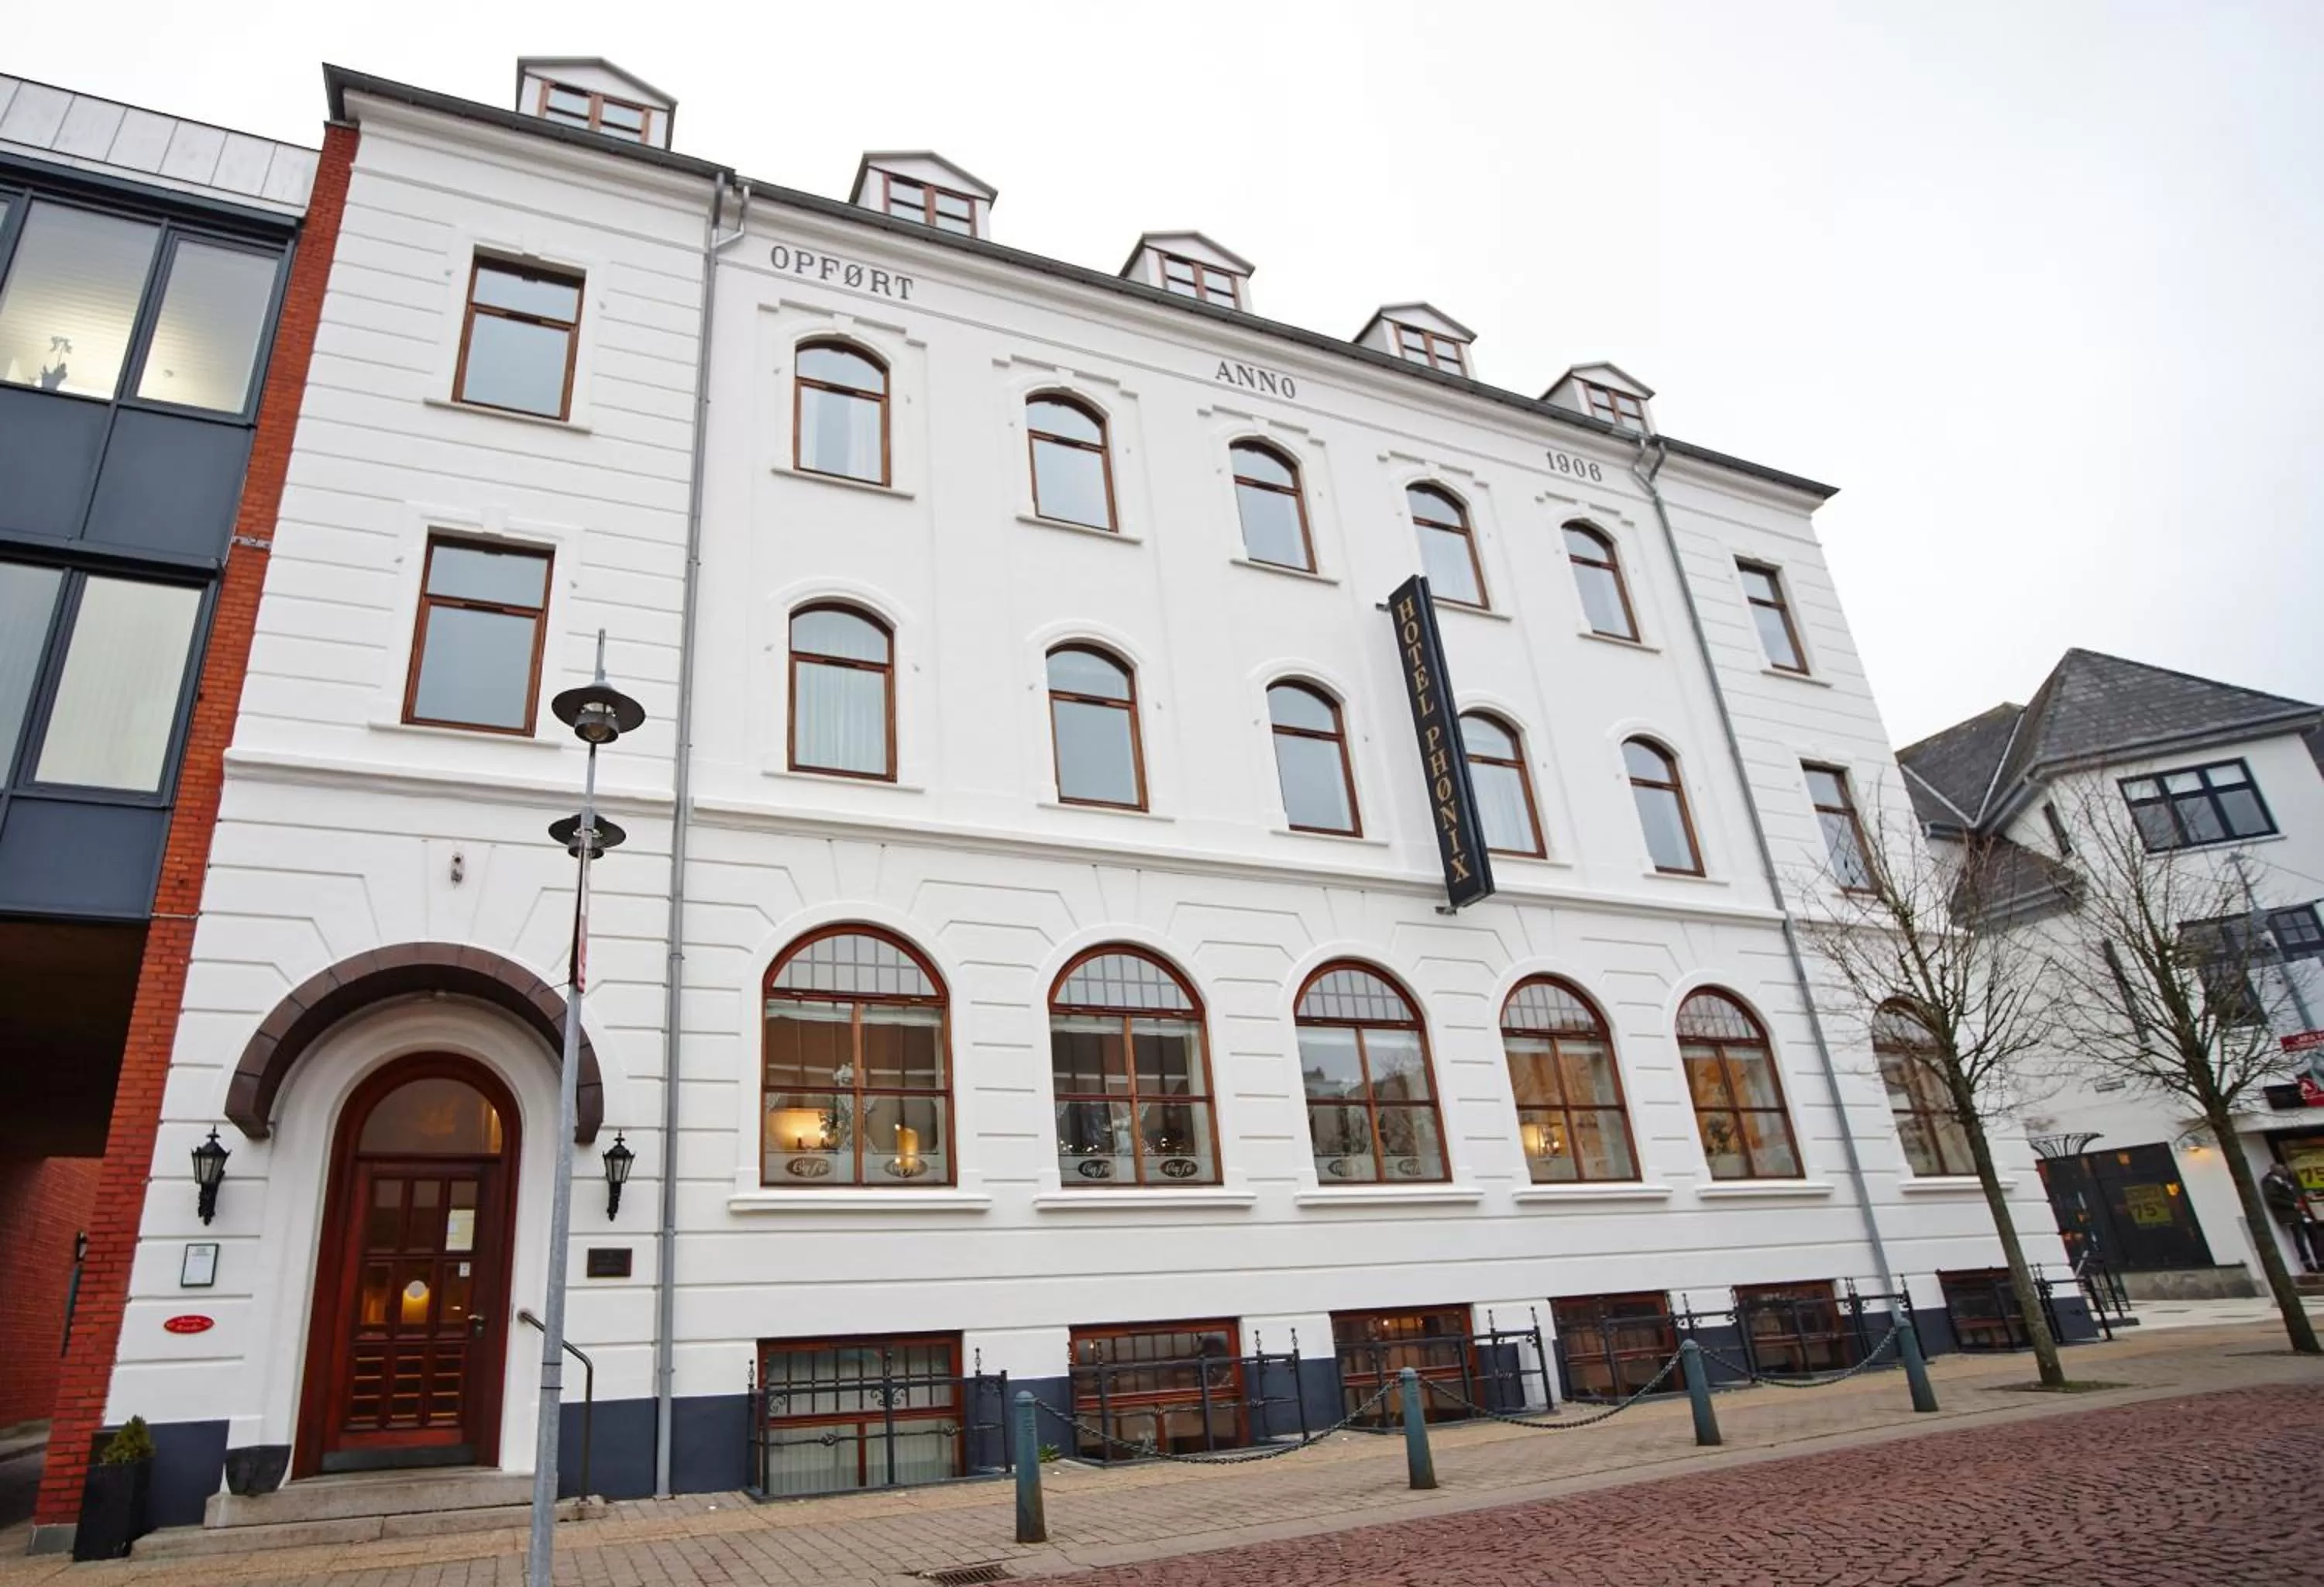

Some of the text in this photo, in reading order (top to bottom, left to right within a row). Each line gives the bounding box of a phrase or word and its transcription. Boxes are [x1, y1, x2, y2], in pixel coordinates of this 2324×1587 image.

[770, 245, 914, 301] OPFØRT
[1215, 360, 1296, 399] ANNO
[1397, 594, 1471, 884] HOTEL PHØNIX
